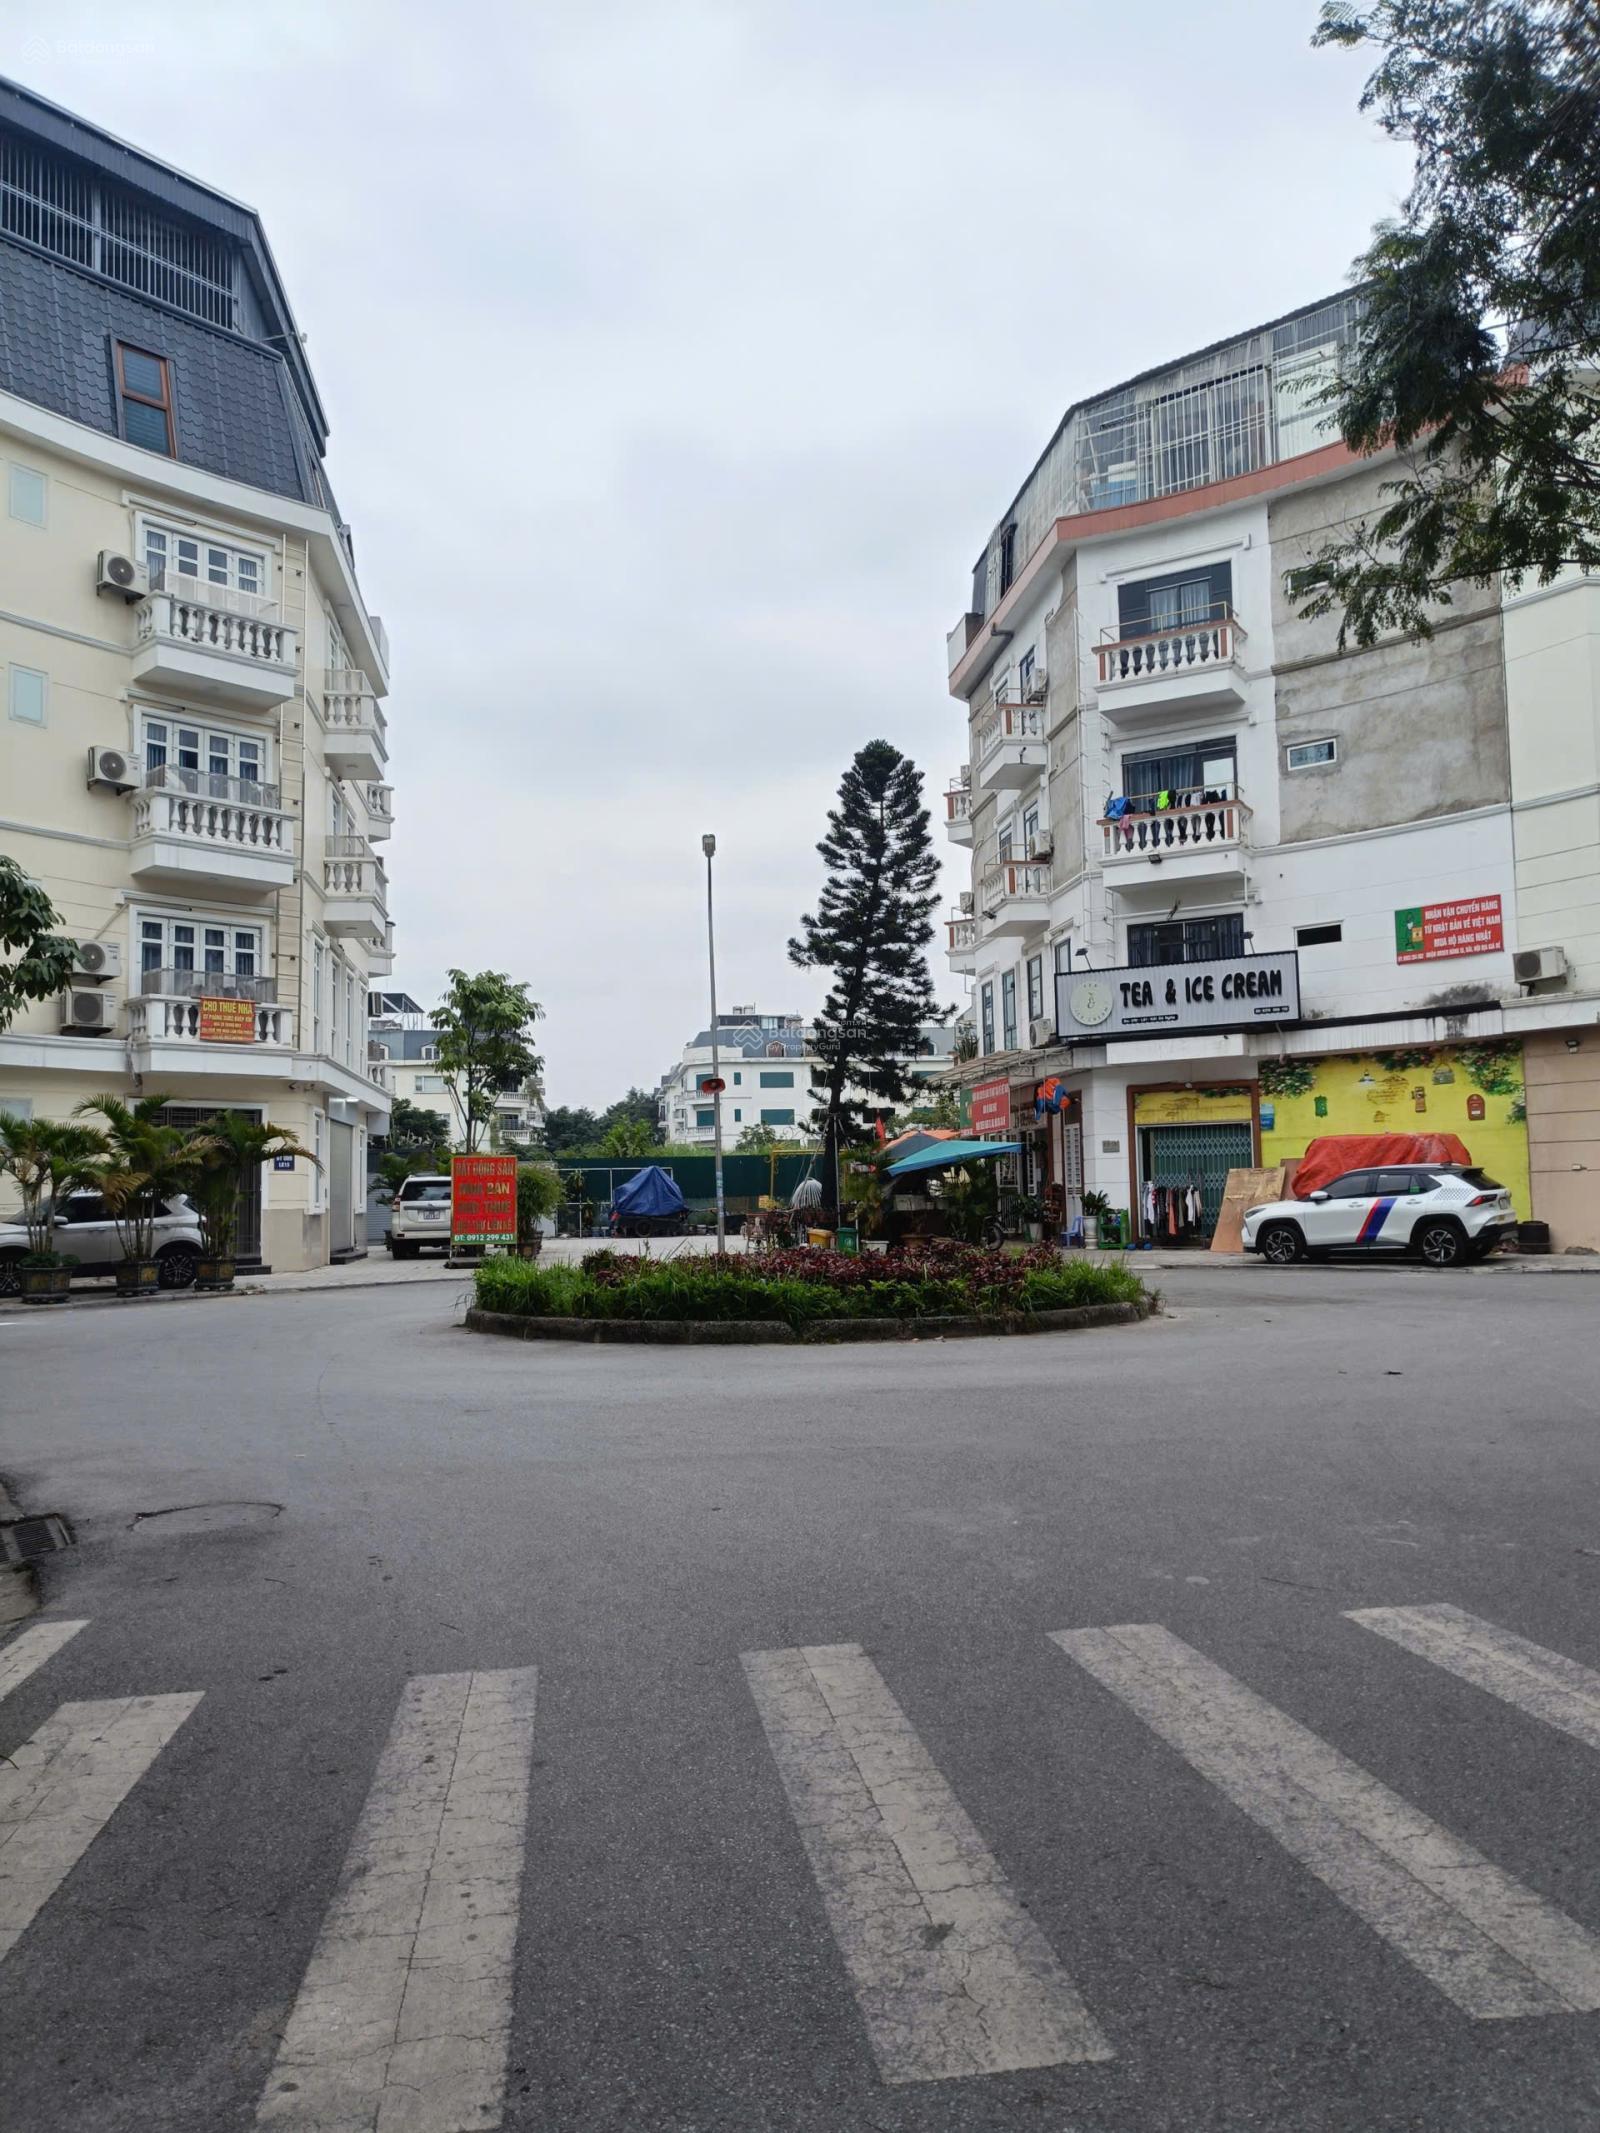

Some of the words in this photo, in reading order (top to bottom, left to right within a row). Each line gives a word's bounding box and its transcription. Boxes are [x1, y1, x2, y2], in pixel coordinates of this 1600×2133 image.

[1424, 908, 1442, 921] NHẬN
[1442, 905, 1455, 919] VẬN
[1456, 900, 1481, 915] CHUYỂN
[1481, 899, 1498, 911] HÀNG
[1432, 920, 1448, 934] NHẬT
[1449, 918, 1462, 931] BẢN
[1472, 916, 1485, 928] VIỆT
[1485, 914, 1501, 925] NAM
[1433, 938, 1447, 948] MUA
[1457, 932, 1475, 945] HÀNG
[1475, 930, 1491, 943] NHẬT
[1120, 980, 1153, 1008] TEA
[1165, 978, 1176, 1004] &
[1185, 975, 1214, 1003] ICE
[1221, 969, 1282, 999] CREAM
[203, 1000, 217, 1011] CHO
[219, 1000, 237, 1013] THUÊ
[501, 1233, 513, 1241] 431
